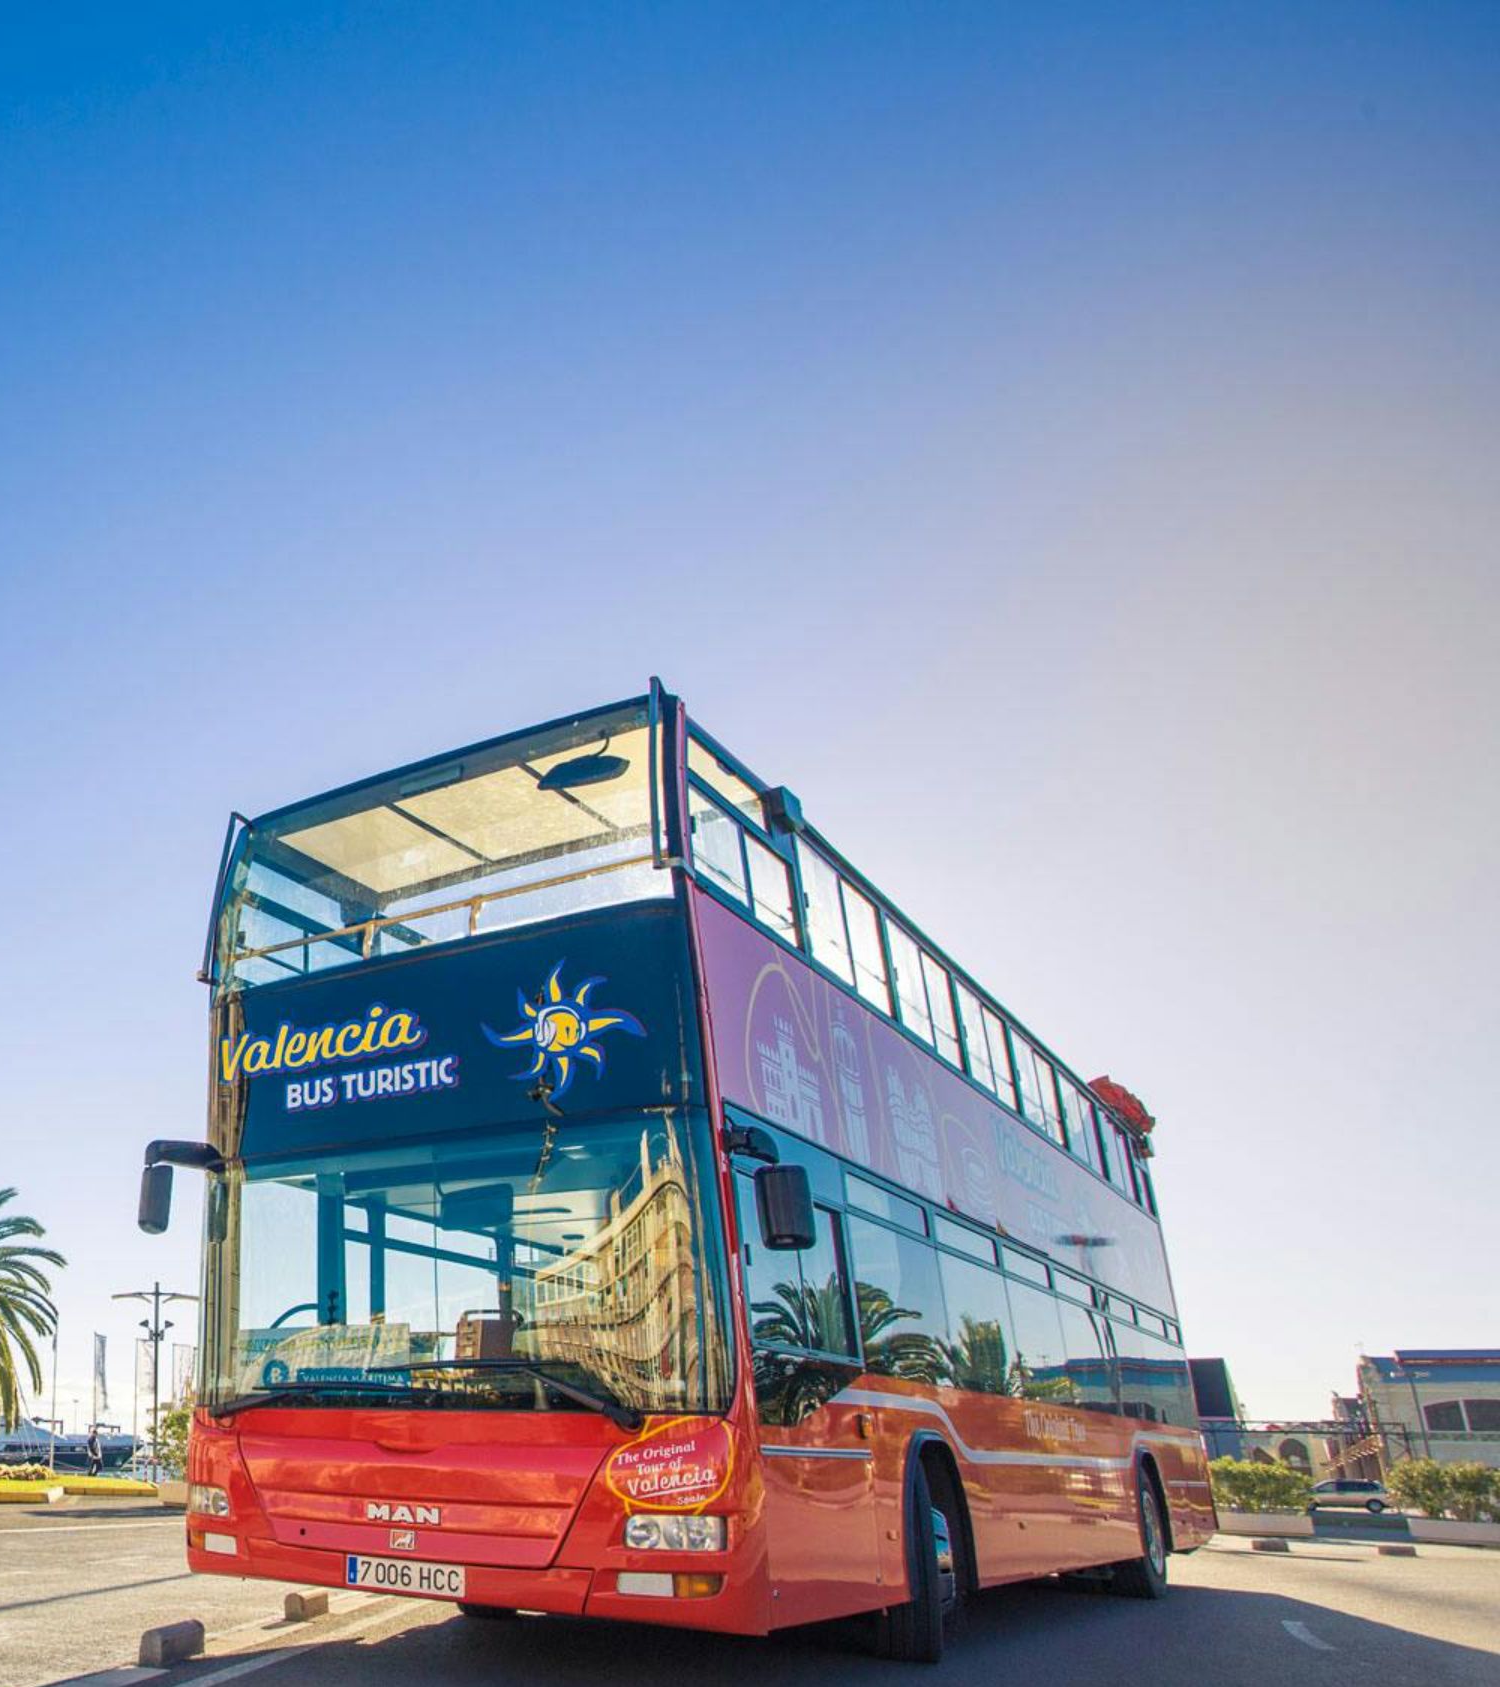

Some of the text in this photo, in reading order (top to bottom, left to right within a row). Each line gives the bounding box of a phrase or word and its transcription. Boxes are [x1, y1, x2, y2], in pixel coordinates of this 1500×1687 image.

[220, 1004, 422, 1081] Valencia
[286, 1057, 456, 1109] BUS TURISTIC
[616, 1440, 696, 1465] The Original
[636, 1456, 683, 1476] Tour of
[627, 1466, 717, 1497] Valencia
[367, 1502, 441, 1525] MAN
[360, 1560, 460, 1593] 7006 HCC
